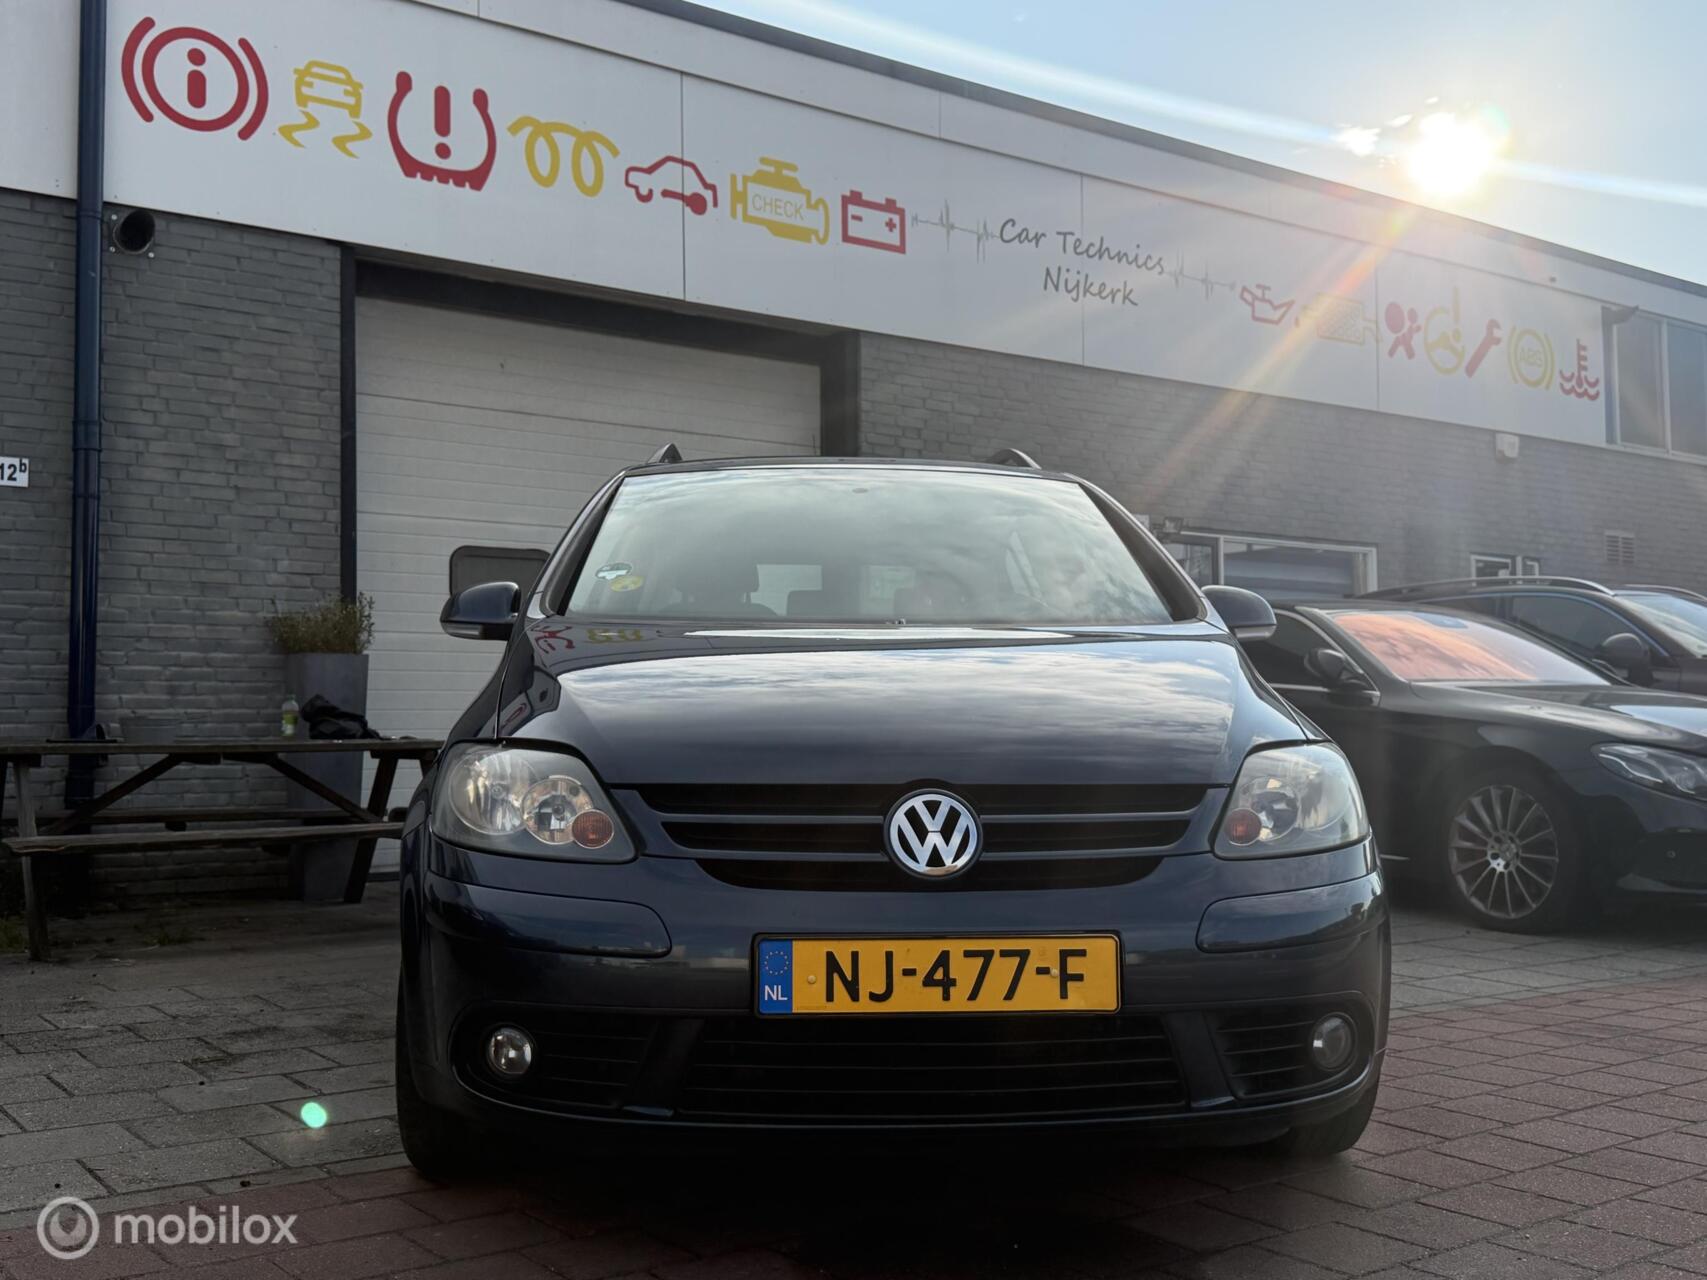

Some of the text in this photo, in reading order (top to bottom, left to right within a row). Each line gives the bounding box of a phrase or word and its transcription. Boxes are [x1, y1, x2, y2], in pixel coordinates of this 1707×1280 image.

[751, 193, 805, 221] CHECK
[1000, 218, 1164, 275] Car Technics
[1043, 265, 1139, 307] Nijkerk
[763, 984, 789, 1001] NL
[825, 948, 1088, 1003] NJ-477-F
